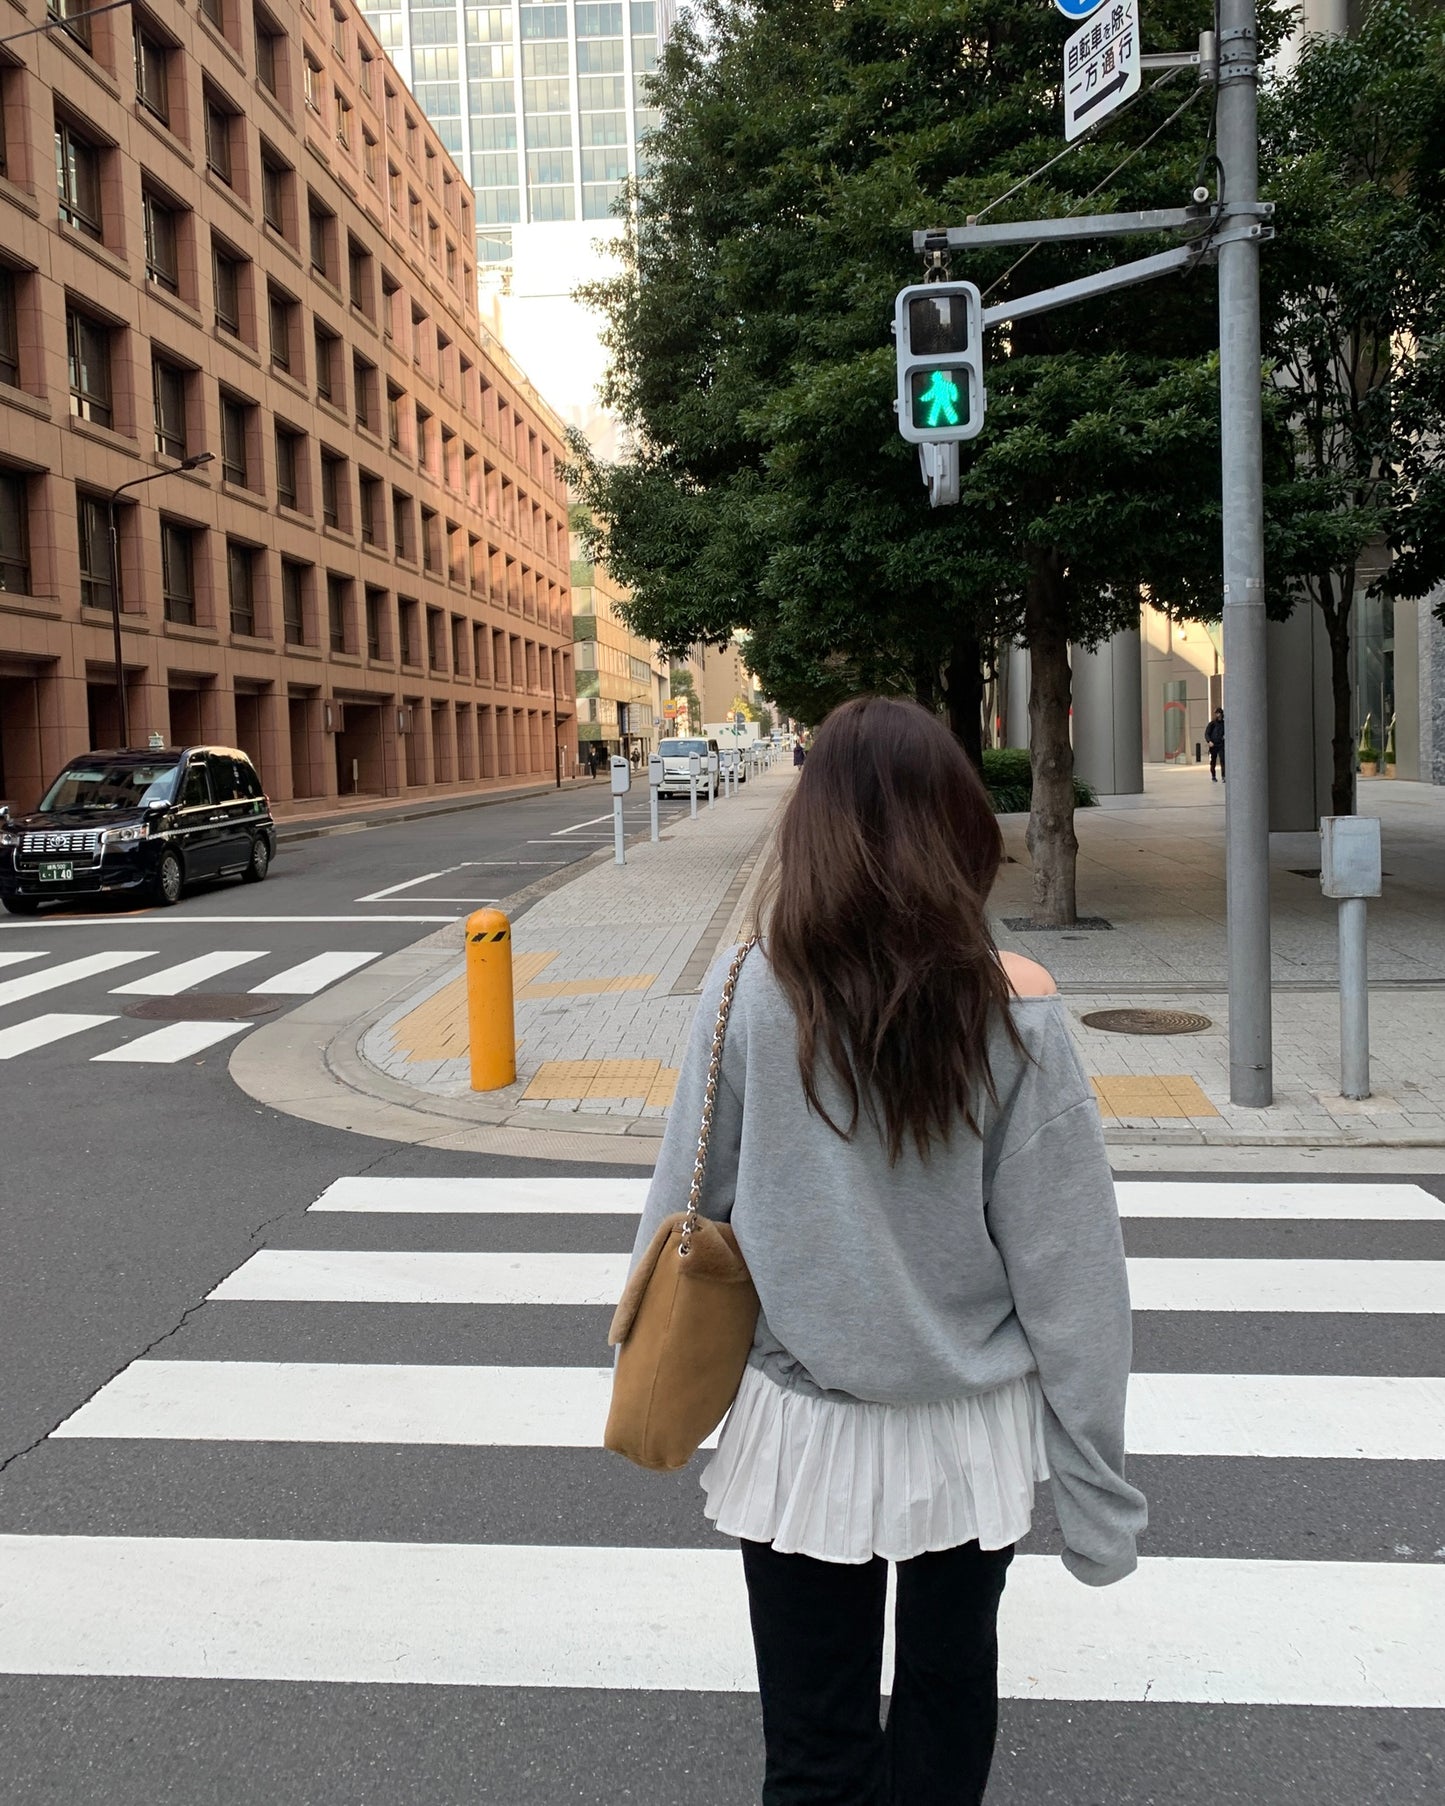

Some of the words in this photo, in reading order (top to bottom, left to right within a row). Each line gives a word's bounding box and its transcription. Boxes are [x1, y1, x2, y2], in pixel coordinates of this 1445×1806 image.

[1069, 2, 1132, 72] 自転車を除く
[1070, 32, 1133, 94] 一方通行
